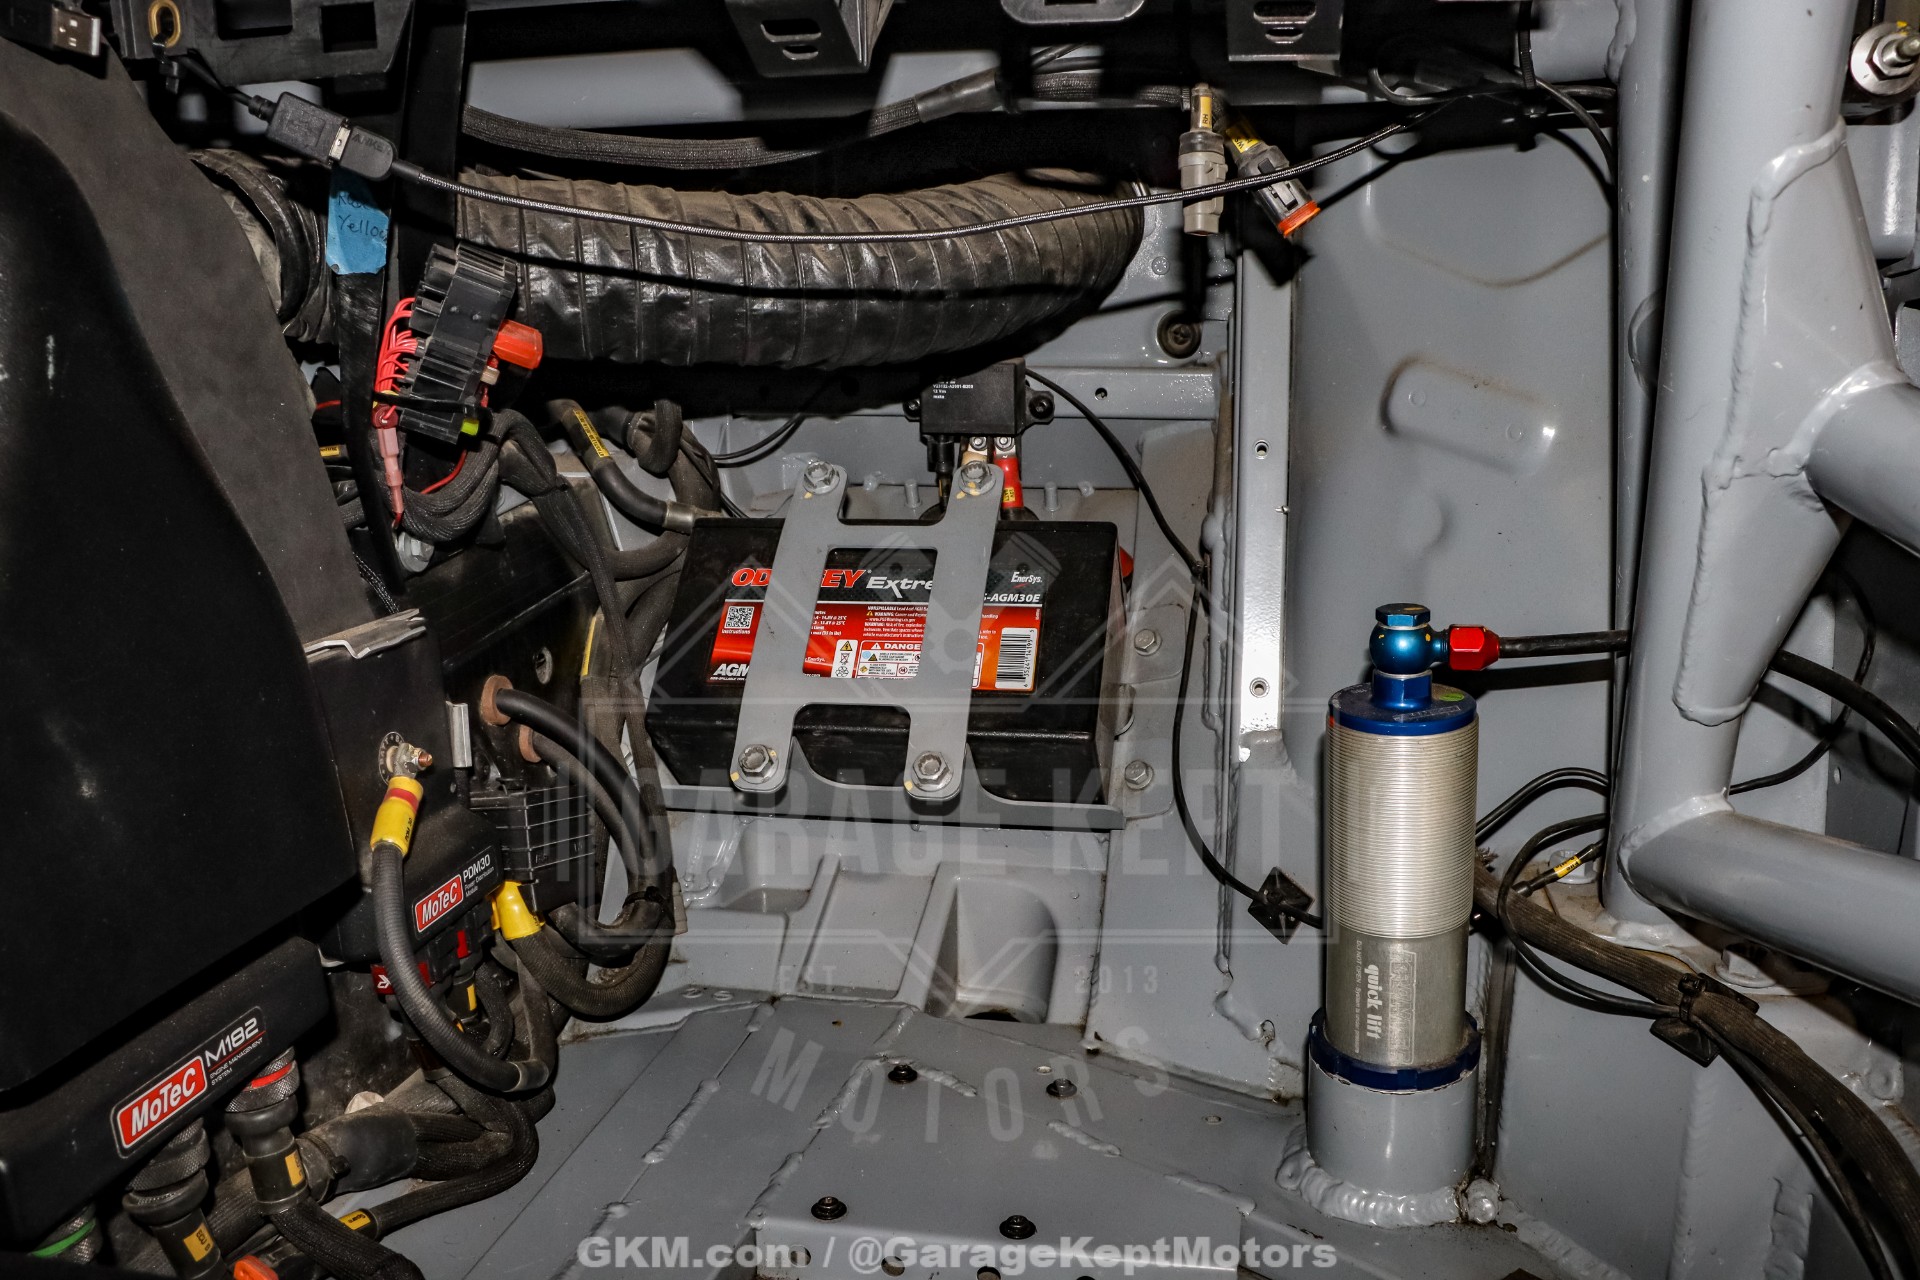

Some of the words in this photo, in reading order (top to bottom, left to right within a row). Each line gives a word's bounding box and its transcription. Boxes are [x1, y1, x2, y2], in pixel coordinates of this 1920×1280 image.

[1202, 113, 1209, 124] RH
[731, 567, 866, 588] ODEY
[866, 576, 933, 599] Extre
[884, 642, 921, 650] DANGE
[463, 854, 491, 883] PDM30
[422, 881, 458, 925] MoTeC
[1364, 963, 1383, 1010] quick
[1366, 1013, 1383, 1040] lift
[204, 1016, 260, 1068] M182
[209, 1061, 229, 1080] ENGINE
[228, 1036, 264, 1066] MANAGEMENT
[211, 1067, 233, 1087] SYSTEM
[131, 1067, 196, 1137] MoTeC
[196, 1228, 208, 1246] ECU
